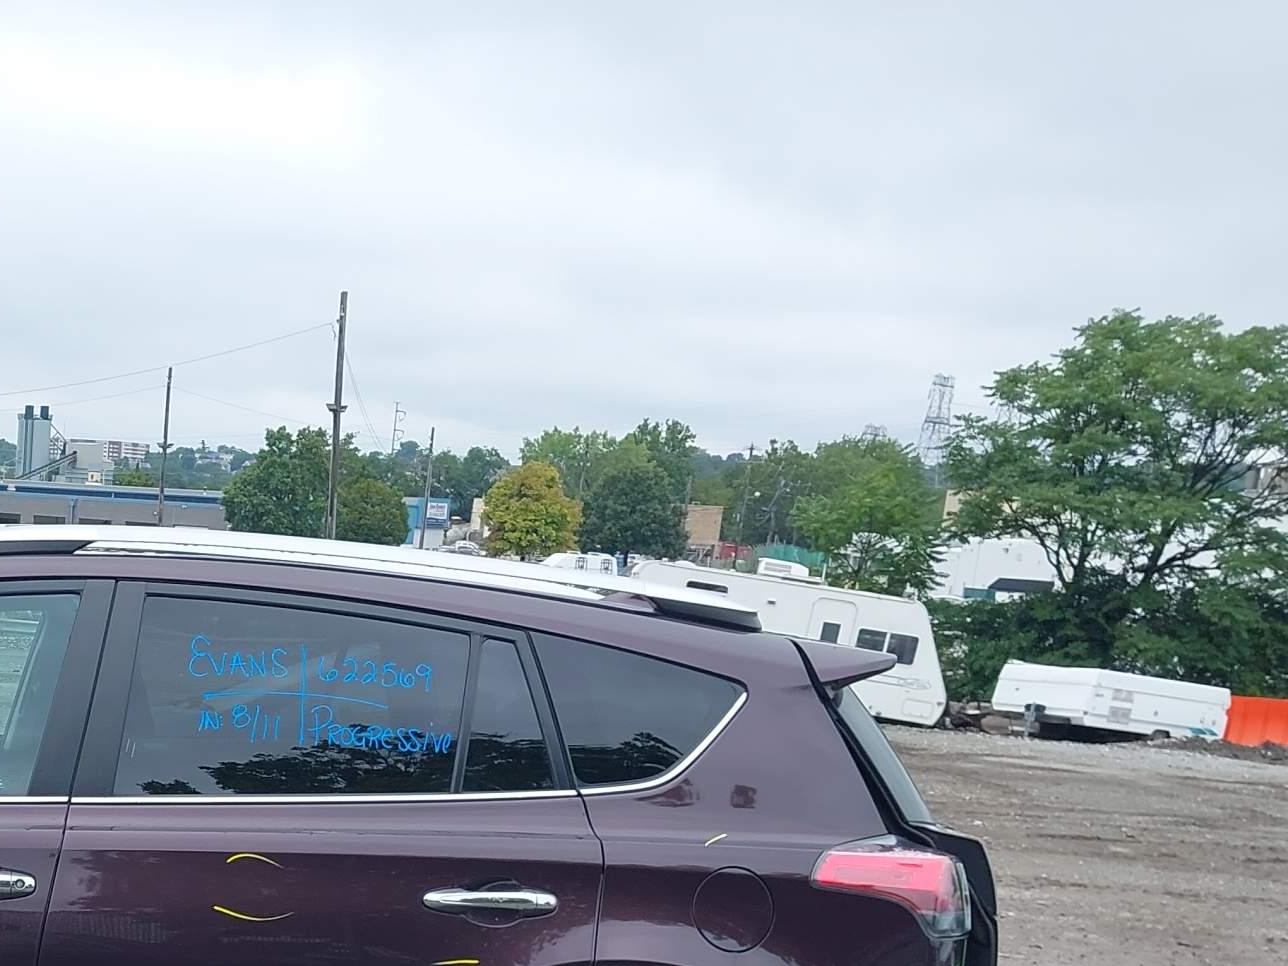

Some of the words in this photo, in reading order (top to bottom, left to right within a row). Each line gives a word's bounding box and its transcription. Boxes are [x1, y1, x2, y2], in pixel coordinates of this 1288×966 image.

[188, 634, 289, 678] EVANS
[318, 655, 433, 692] 622569
[232, 704, 281, 743] 8/11
